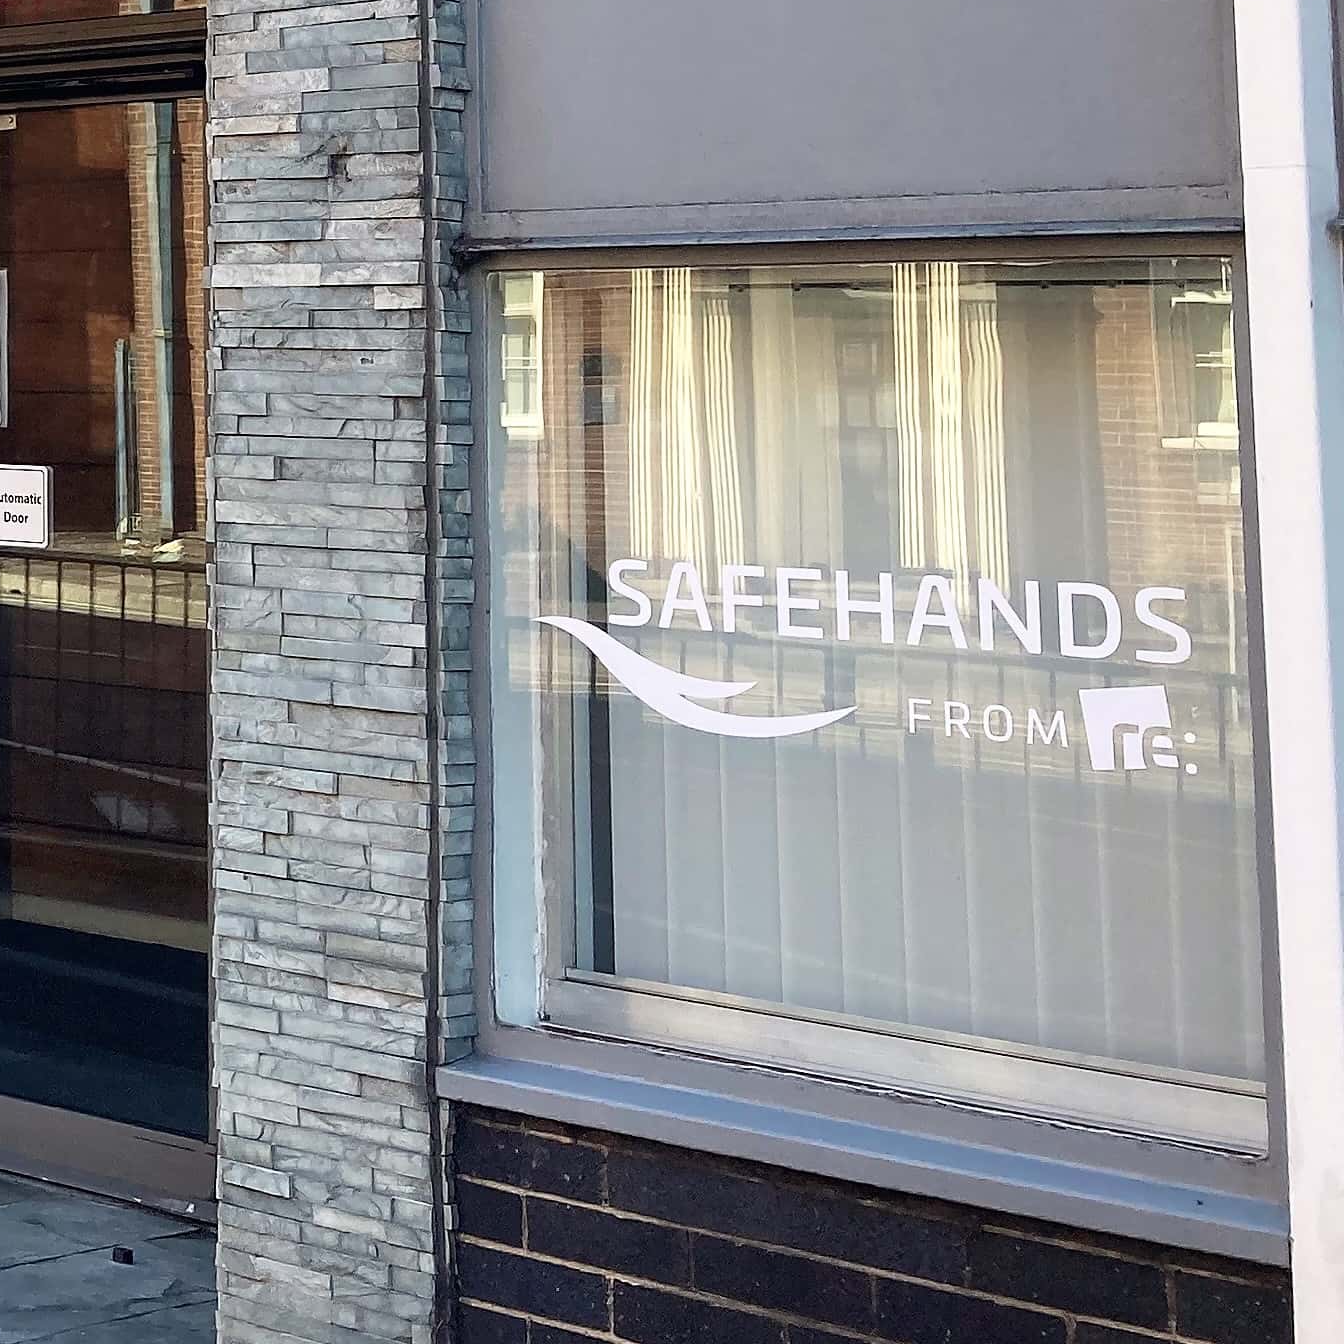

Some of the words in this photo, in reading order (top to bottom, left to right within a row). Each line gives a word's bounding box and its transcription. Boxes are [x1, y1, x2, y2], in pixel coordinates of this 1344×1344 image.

[3, 511, 29, 524] Door
[608, 558, 1193, 665] SAFEHANDS
[906, 697, 1069, 748] FROM
